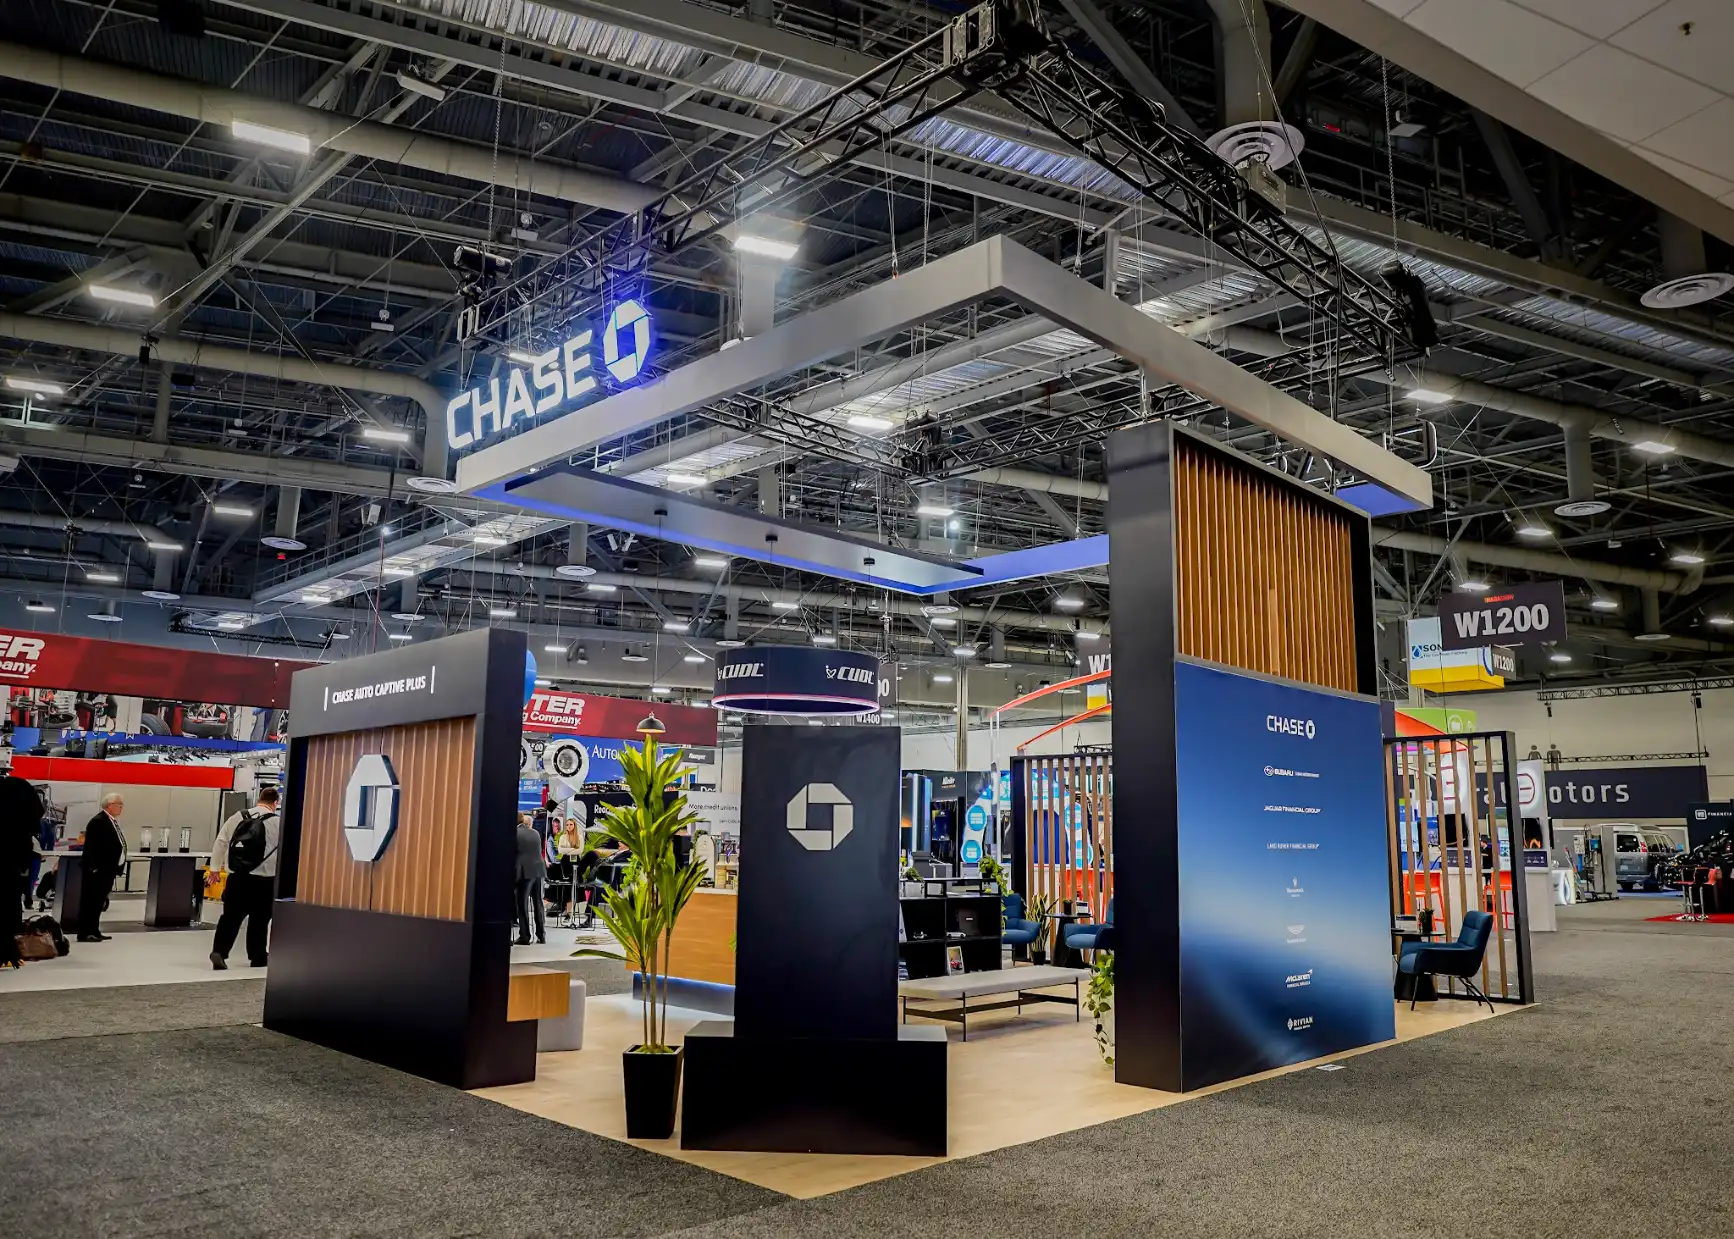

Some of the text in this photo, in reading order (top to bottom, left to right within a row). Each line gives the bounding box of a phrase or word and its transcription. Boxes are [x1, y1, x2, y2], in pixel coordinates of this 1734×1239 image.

[446, 329, 597, 450] CHASE
[1454, 603, 1550, 638] W1200
[0, 635, 45, 660] ER
[0, 661, 36, 675] any.
[722, 664, 763, 678] CUDL
[1493, 653, 1515, 673] W1200
[837, 666, 874, 685] CUDL
[332, 675, 427, 704] CHASE AUTO CAPTIVE PLUS
[523, 693, 585, 716] TER
[856, 714, 880, 724] W1400
[1267, 715, 1304, 736] CHASE
[592, 744, 623, 761] AUTO
[1549, 781, 1630, 804] otors
[1293, 1016, 1314, 1027] RIVIAN
